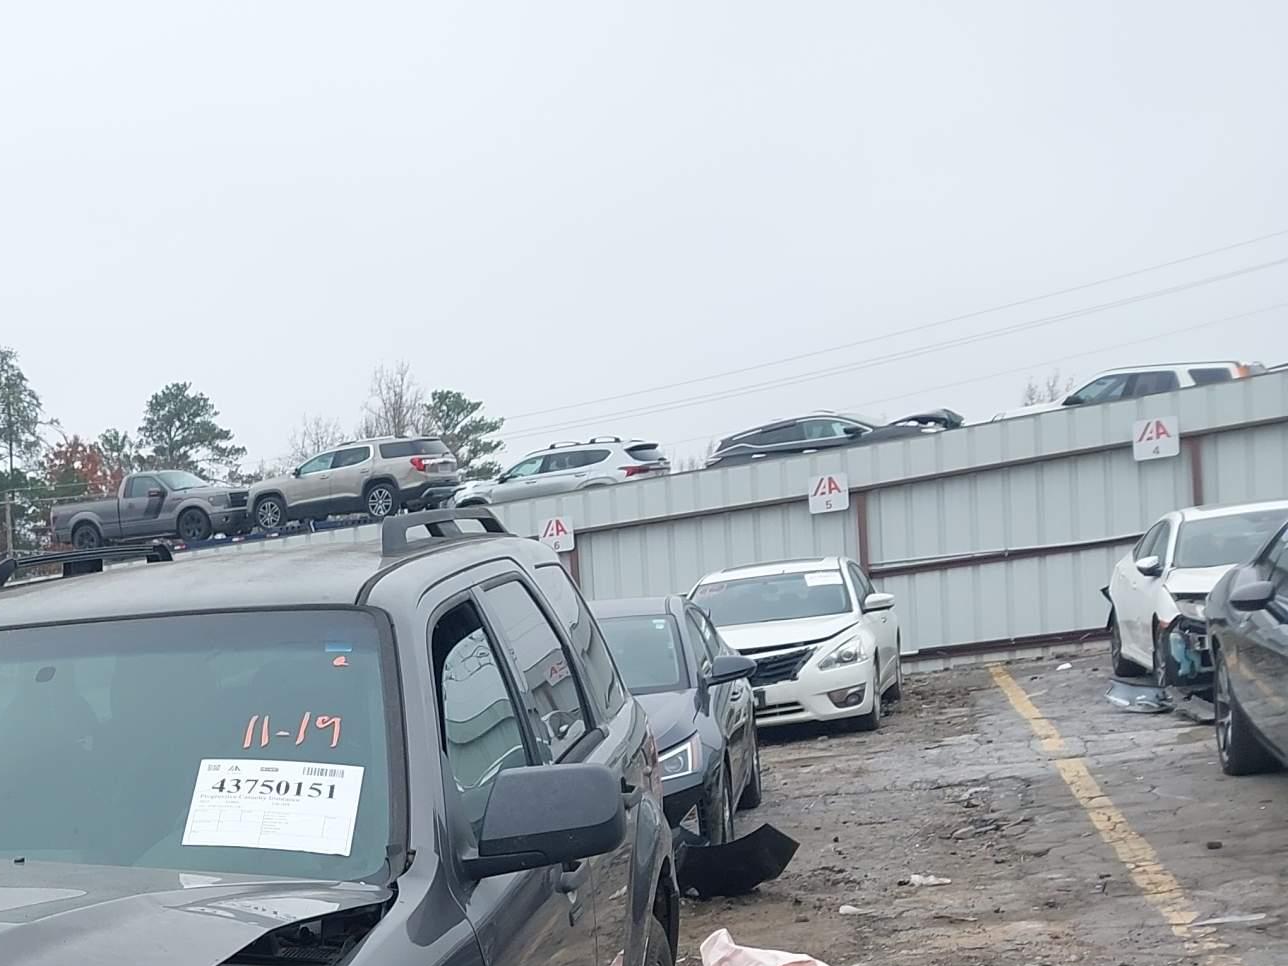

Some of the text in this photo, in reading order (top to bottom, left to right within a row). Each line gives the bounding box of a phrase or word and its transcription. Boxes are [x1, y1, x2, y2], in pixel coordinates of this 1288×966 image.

[1152, 446, 1160, 455] 4
[825, 500, 832, 509] 5
[553, 540, 560, 550] 6
[243, 711, 342, 748] 11-19
[212, 778, 336, 799] 43750151
